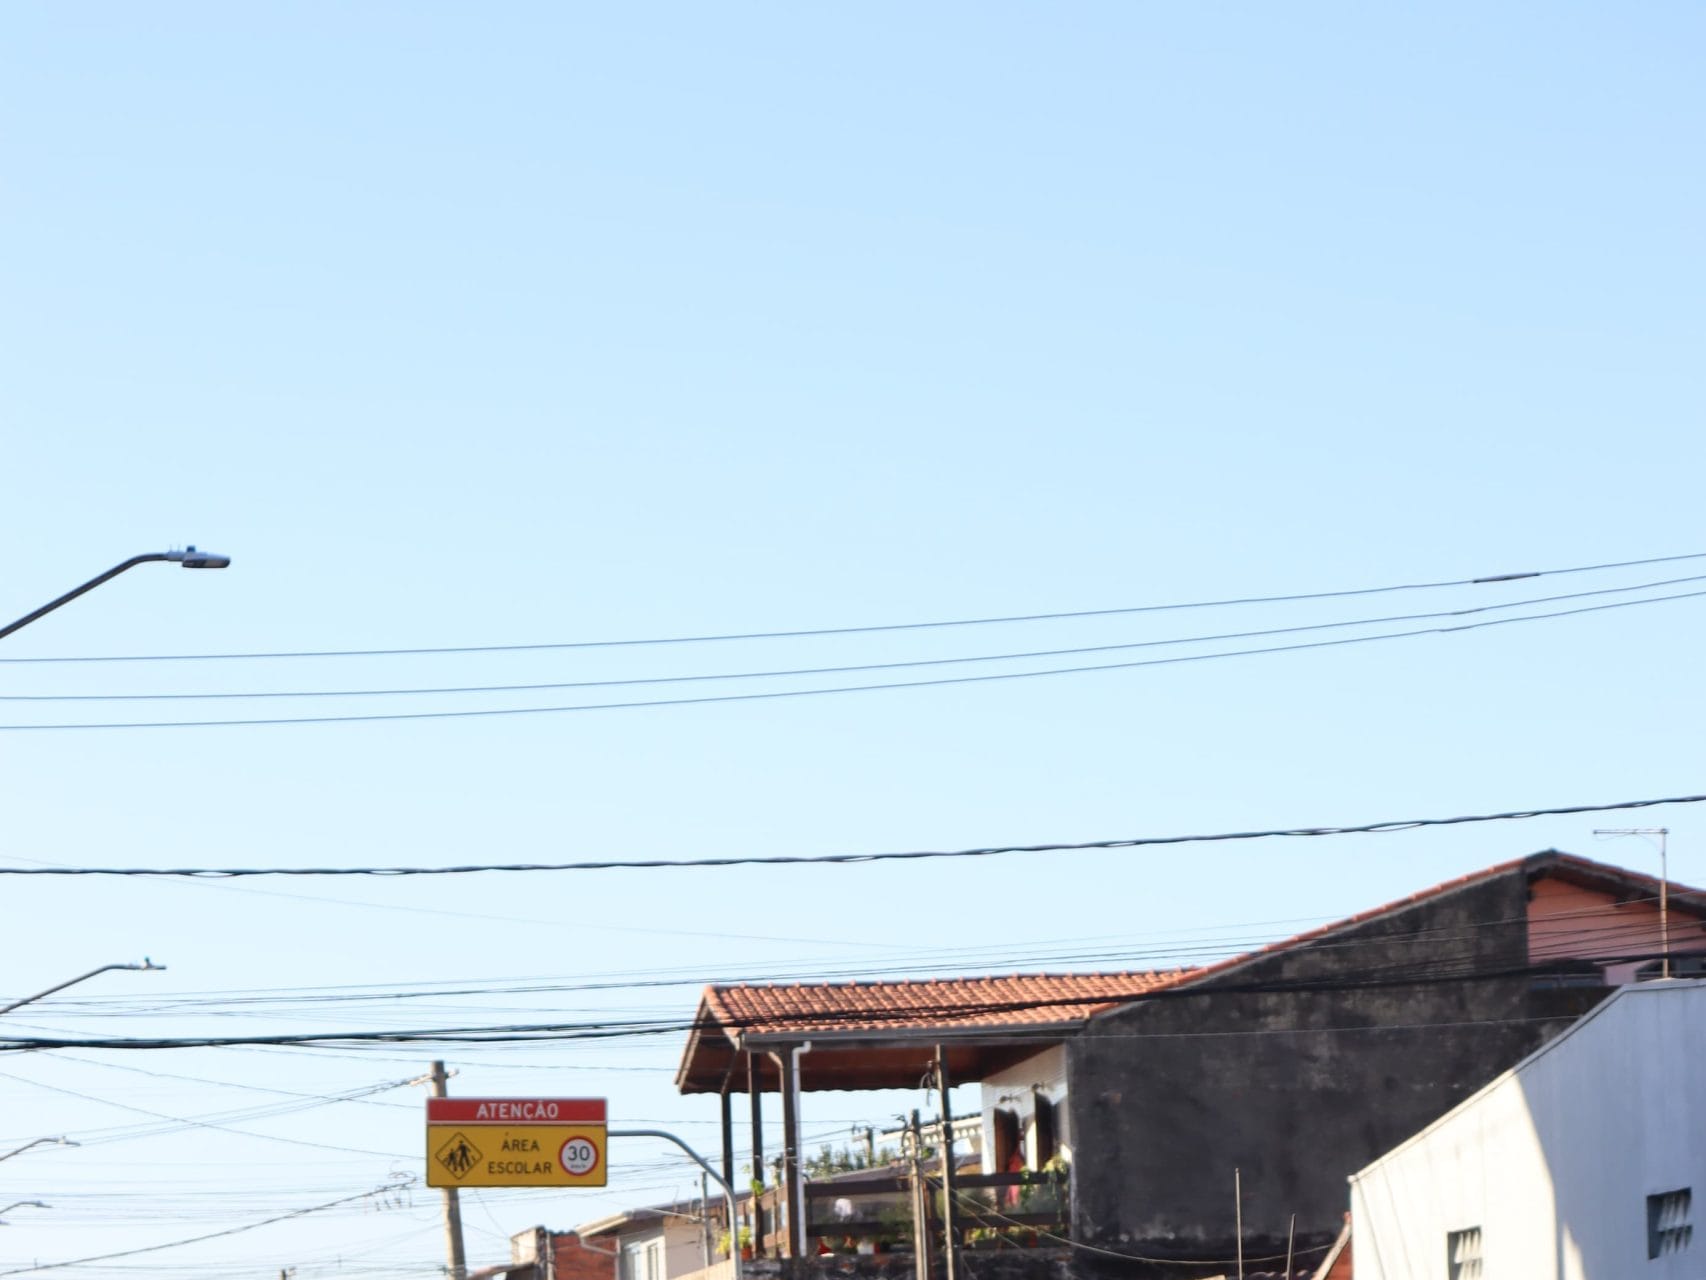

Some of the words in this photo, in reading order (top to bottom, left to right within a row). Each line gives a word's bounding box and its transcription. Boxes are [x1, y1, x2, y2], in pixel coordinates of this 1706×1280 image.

[476, 1101, 559, 1119] ATENÇÃO
[501, 1138, 540, 1152] ÁREA
[567, 1145, 590, 1161] 30
[488, 1162, 552, 1174] ESCOLAR
